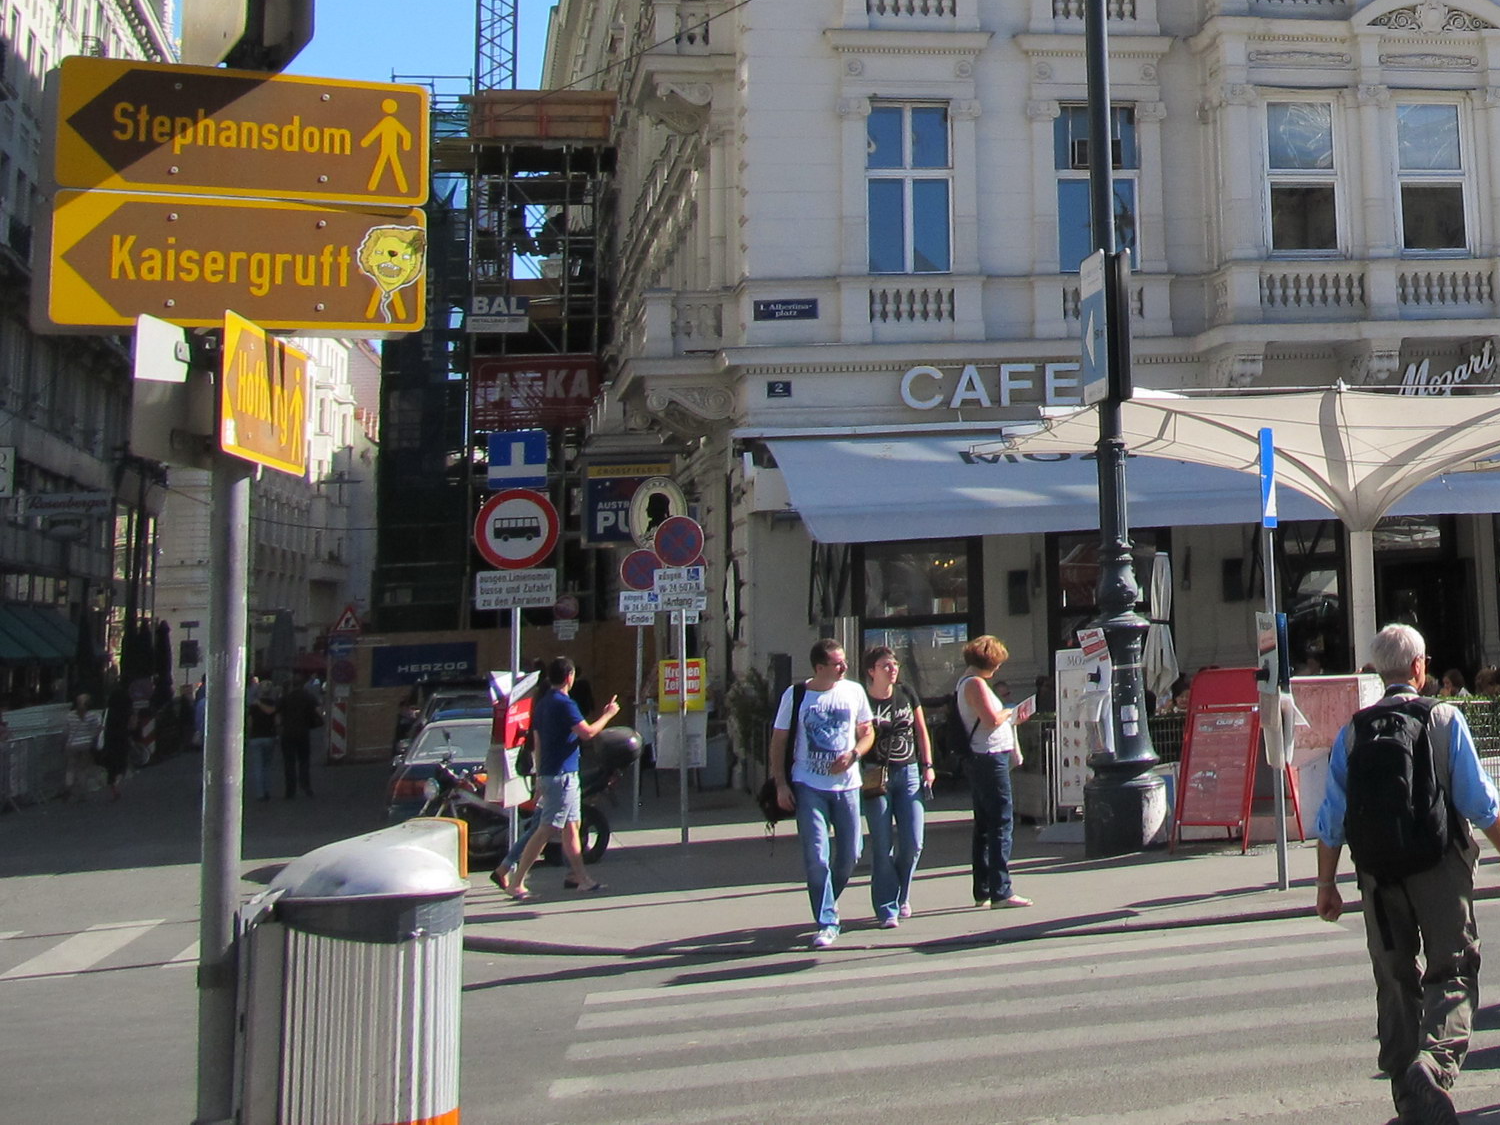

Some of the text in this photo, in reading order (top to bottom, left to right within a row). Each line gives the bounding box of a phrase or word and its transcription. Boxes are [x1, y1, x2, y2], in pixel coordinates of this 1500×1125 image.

[112, 102, 351, 155] Stephansdom
[110, 235, 350, 297] Kaisergruft
[472, 296, 525, 315] BAL
[769, 303, 812, 311] Albertina-
[775, 309, 797, 317] platz
[1399, 340, 1494, 395] Mozart
[774, 383, 784, 392] 2
[901, 363, 1082, 409] CAFE
[506, 585, 520, 594] und
[523, 583, 552, 592] Zufahrt
[495, 597, 508, 605] den
[397, 661, 468, 673] HERZOG
[665, 666, 700, 677] Kroen
[665, 678, 700, 691] Zeing
